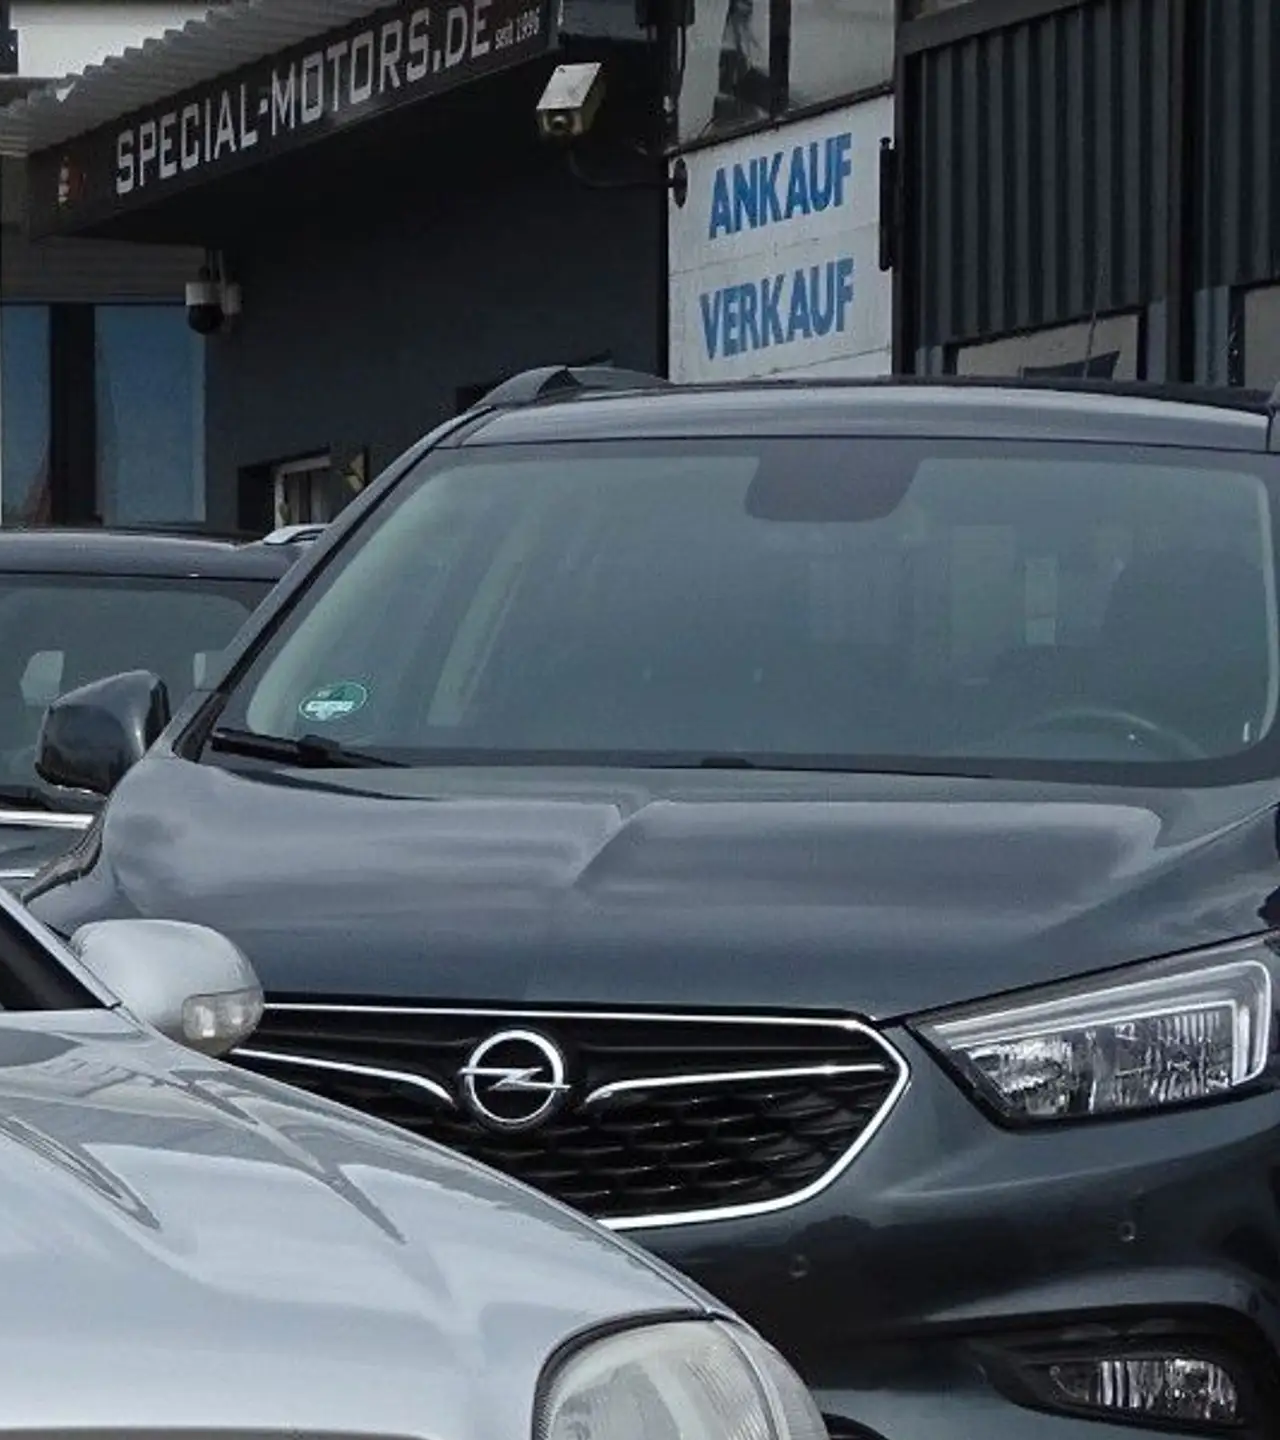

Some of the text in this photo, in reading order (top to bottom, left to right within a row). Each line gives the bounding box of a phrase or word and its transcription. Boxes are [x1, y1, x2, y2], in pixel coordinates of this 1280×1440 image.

[116, 0, 491, 195] SPECIAL-MOTORS.DE
[707, 132, 852, 239] ANKAUF
[699, 257, 854, 360] VERKAUF
